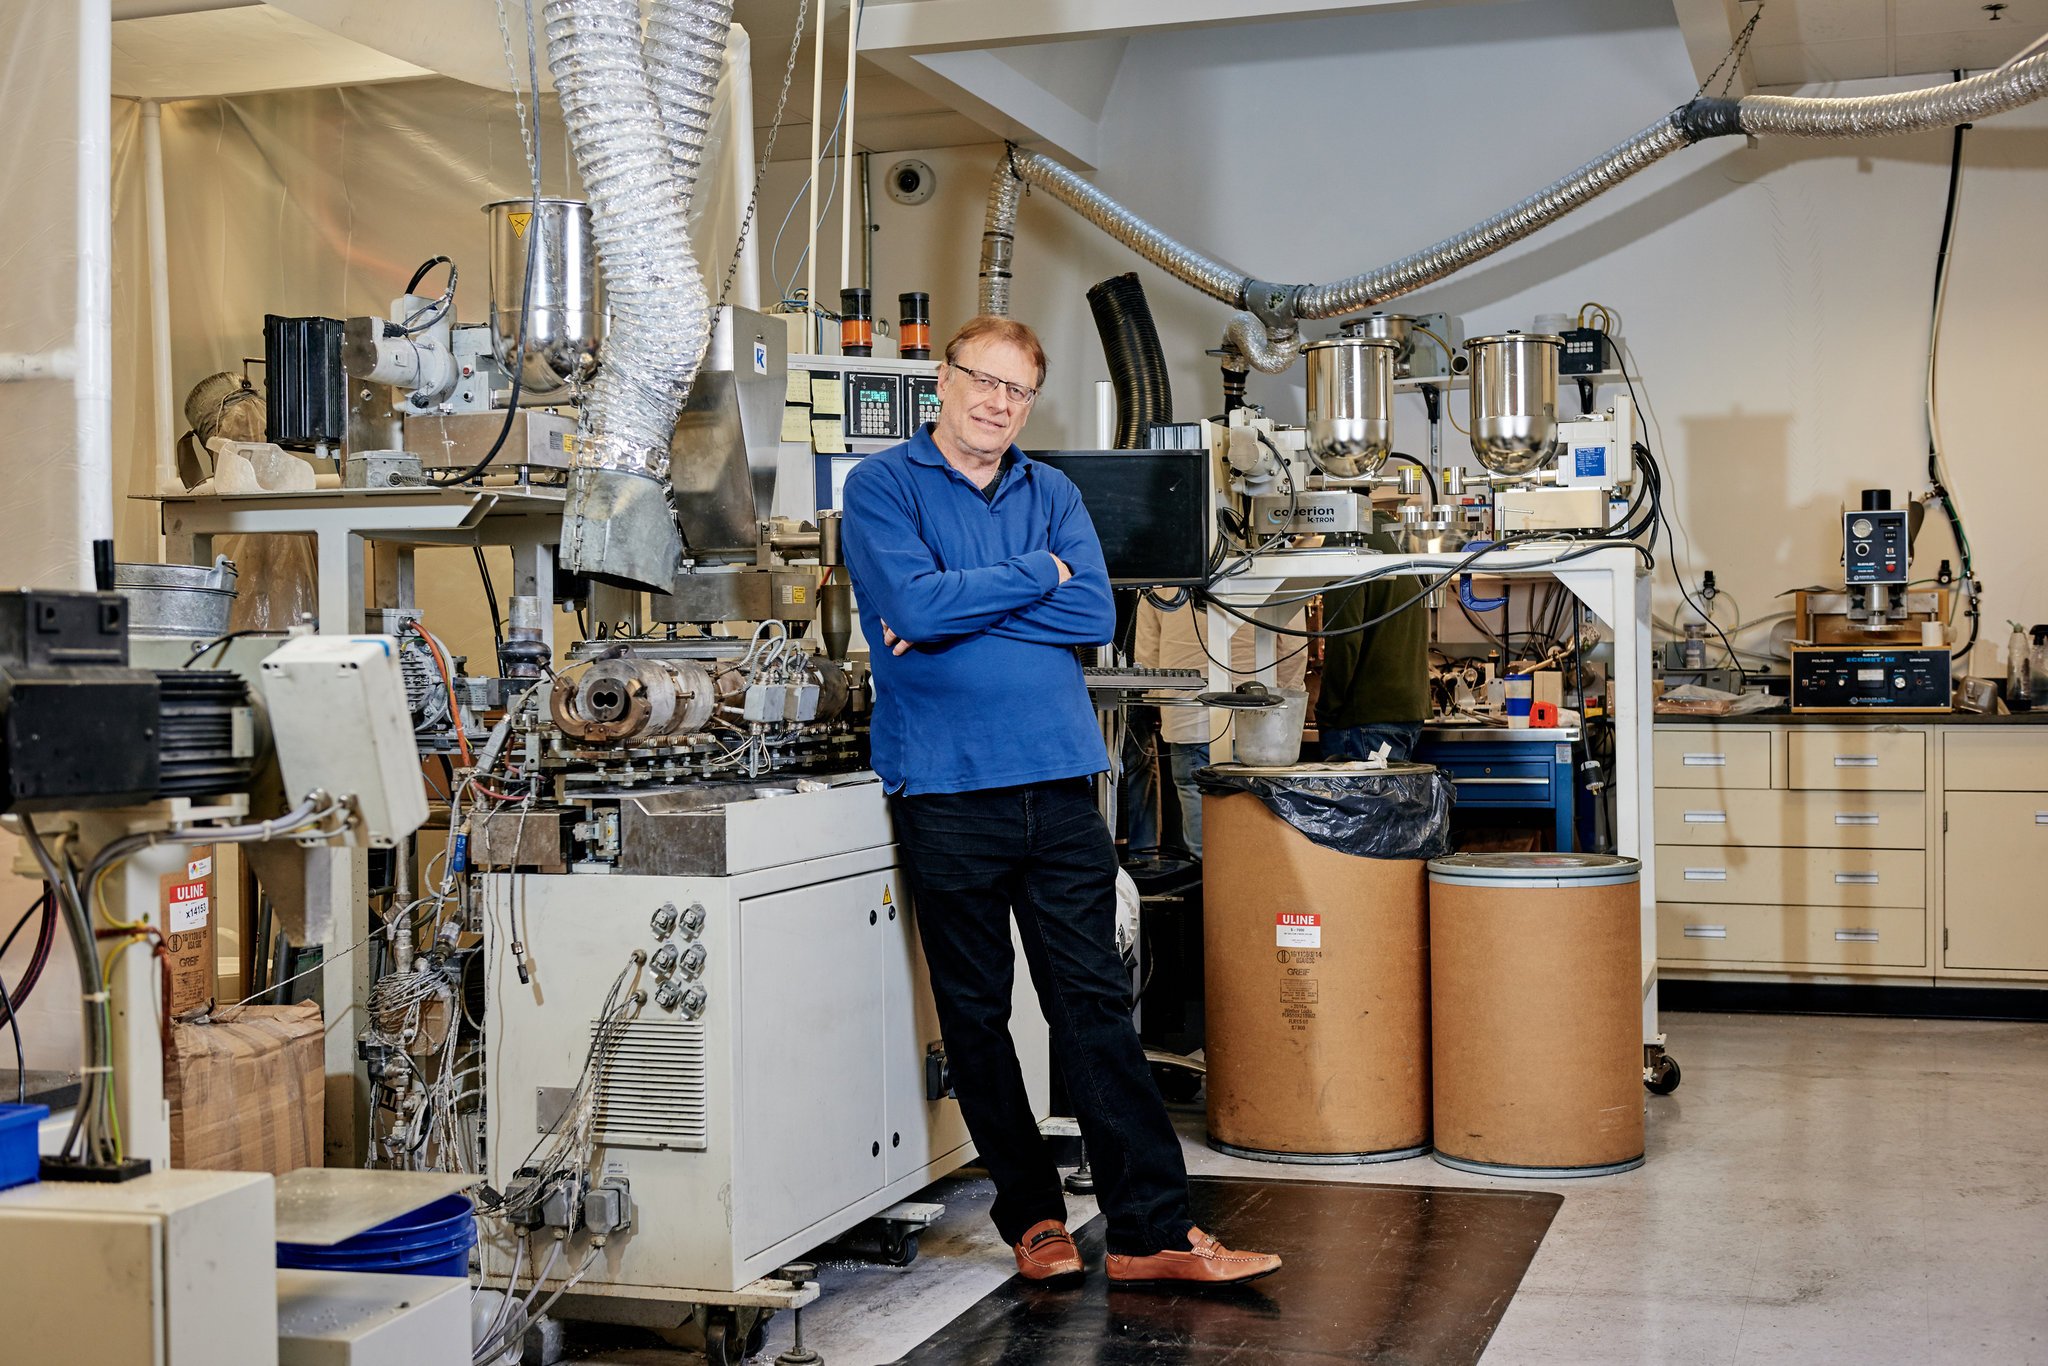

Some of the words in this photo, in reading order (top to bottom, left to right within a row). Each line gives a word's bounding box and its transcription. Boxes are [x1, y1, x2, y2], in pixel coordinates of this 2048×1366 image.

[177, 883, 204, 901] ULINE
[185, 902, 207, 919] x14153
[1282, 914, 1315, 925] ULINE
[1287, 967, 1311, 976] GREIF
